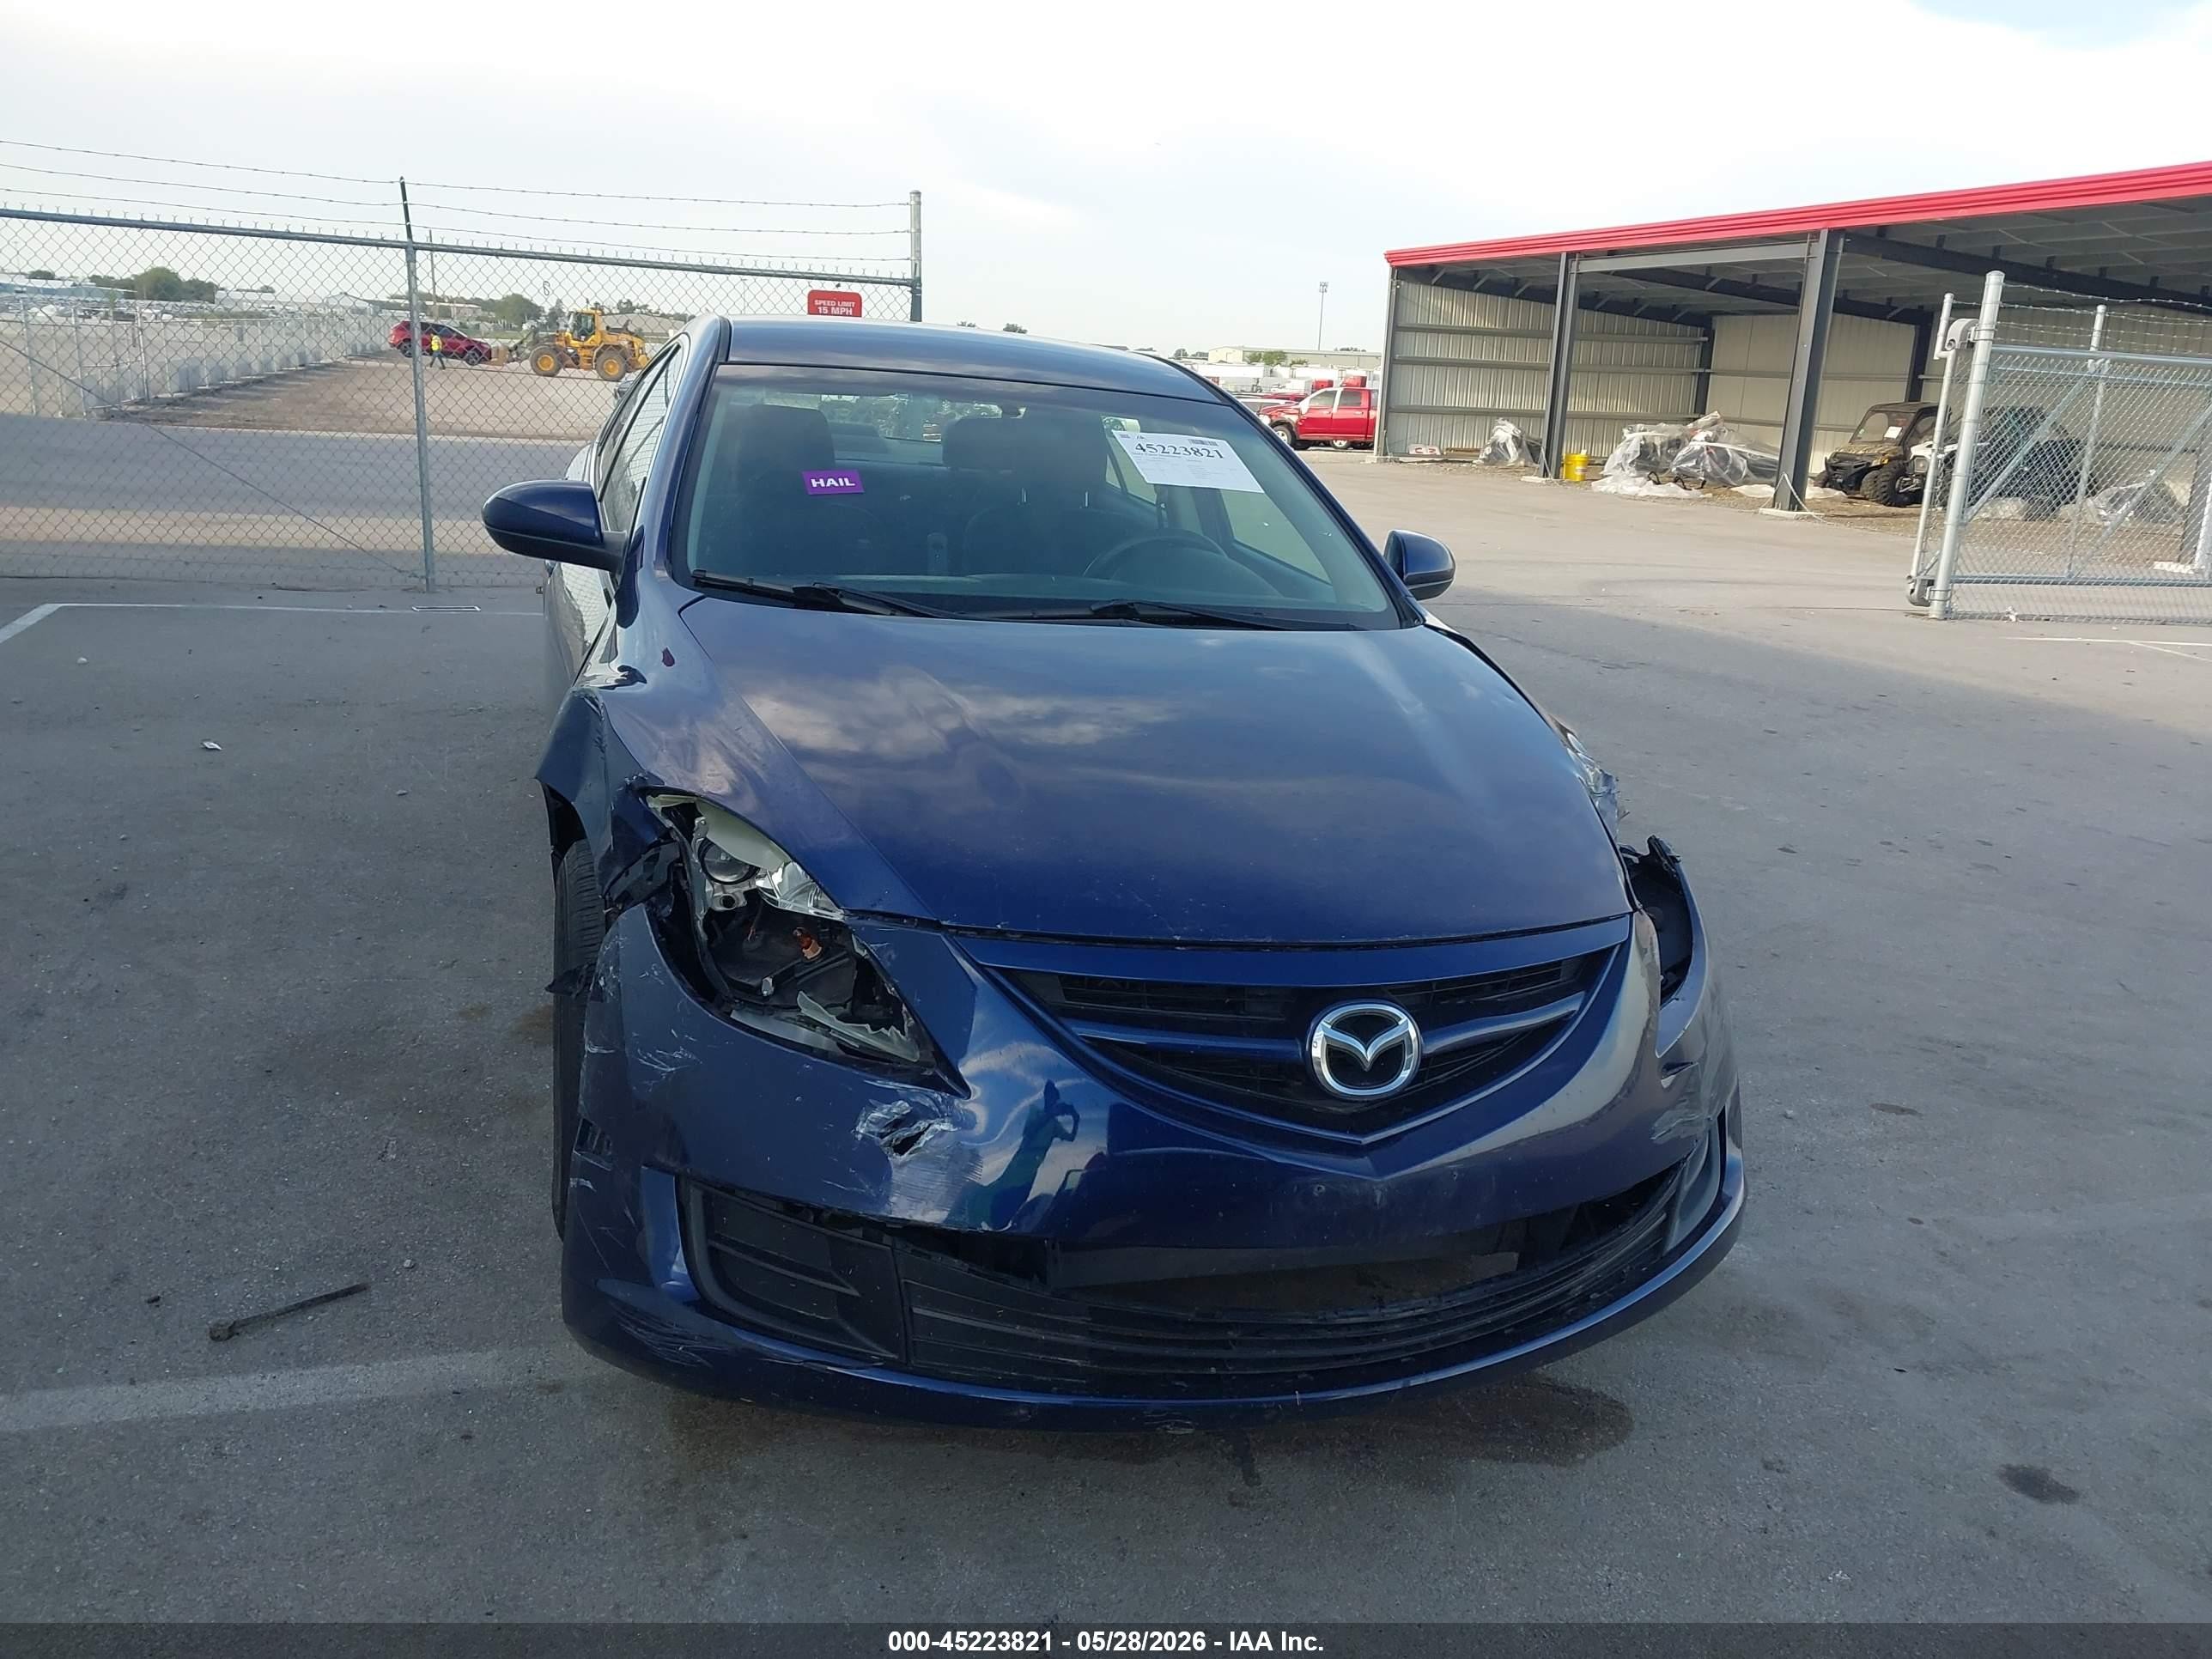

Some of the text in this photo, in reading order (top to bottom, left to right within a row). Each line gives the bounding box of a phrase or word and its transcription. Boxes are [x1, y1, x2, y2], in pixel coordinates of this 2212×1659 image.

[830, 307, 853, 316] MPH
[1135, 442, 1224, 459] 45223821
[810, 477, 856, 488] HAIL
